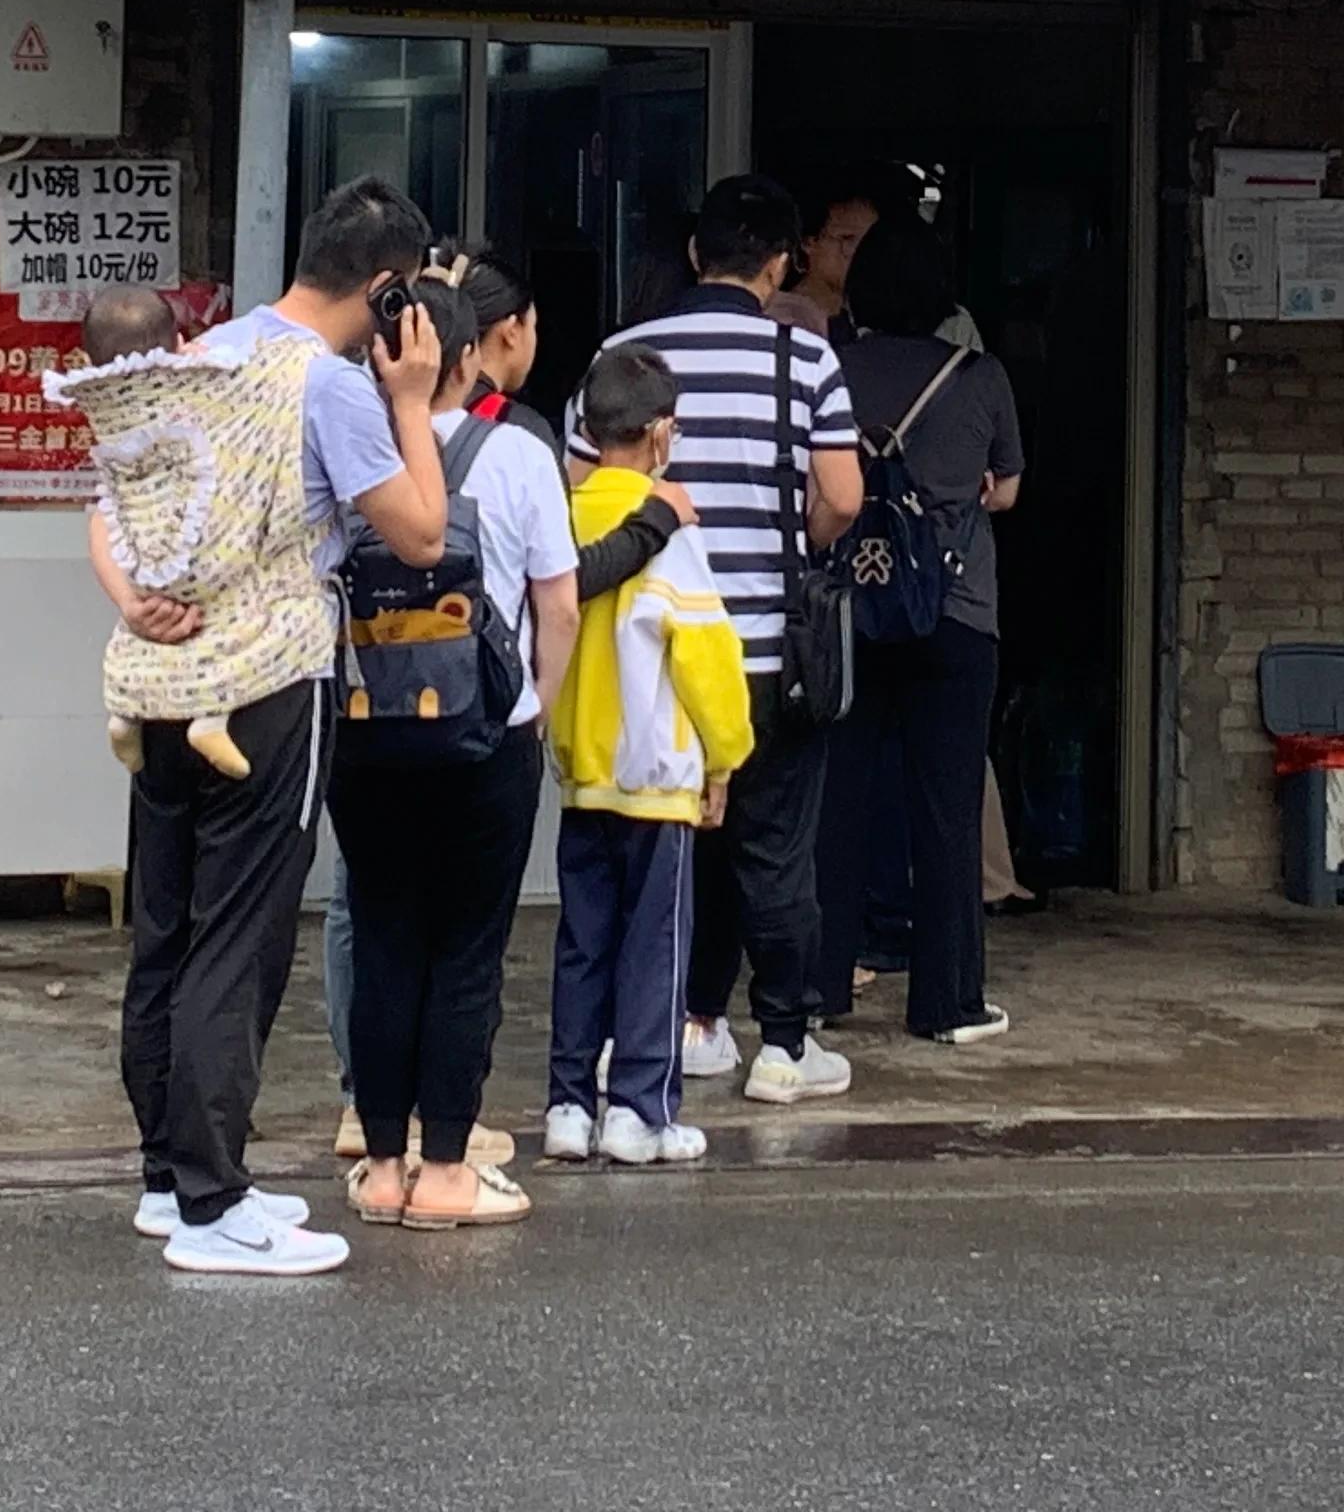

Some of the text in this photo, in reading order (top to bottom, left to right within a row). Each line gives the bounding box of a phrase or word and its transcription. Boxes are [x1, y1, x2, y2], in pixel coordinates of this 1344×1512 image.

[7, 164, 172, 199] 小碗 10元
[7, 210, 172, 245] 大碗 12元
[21, 251, 159, 284] 加帽 10元/份
